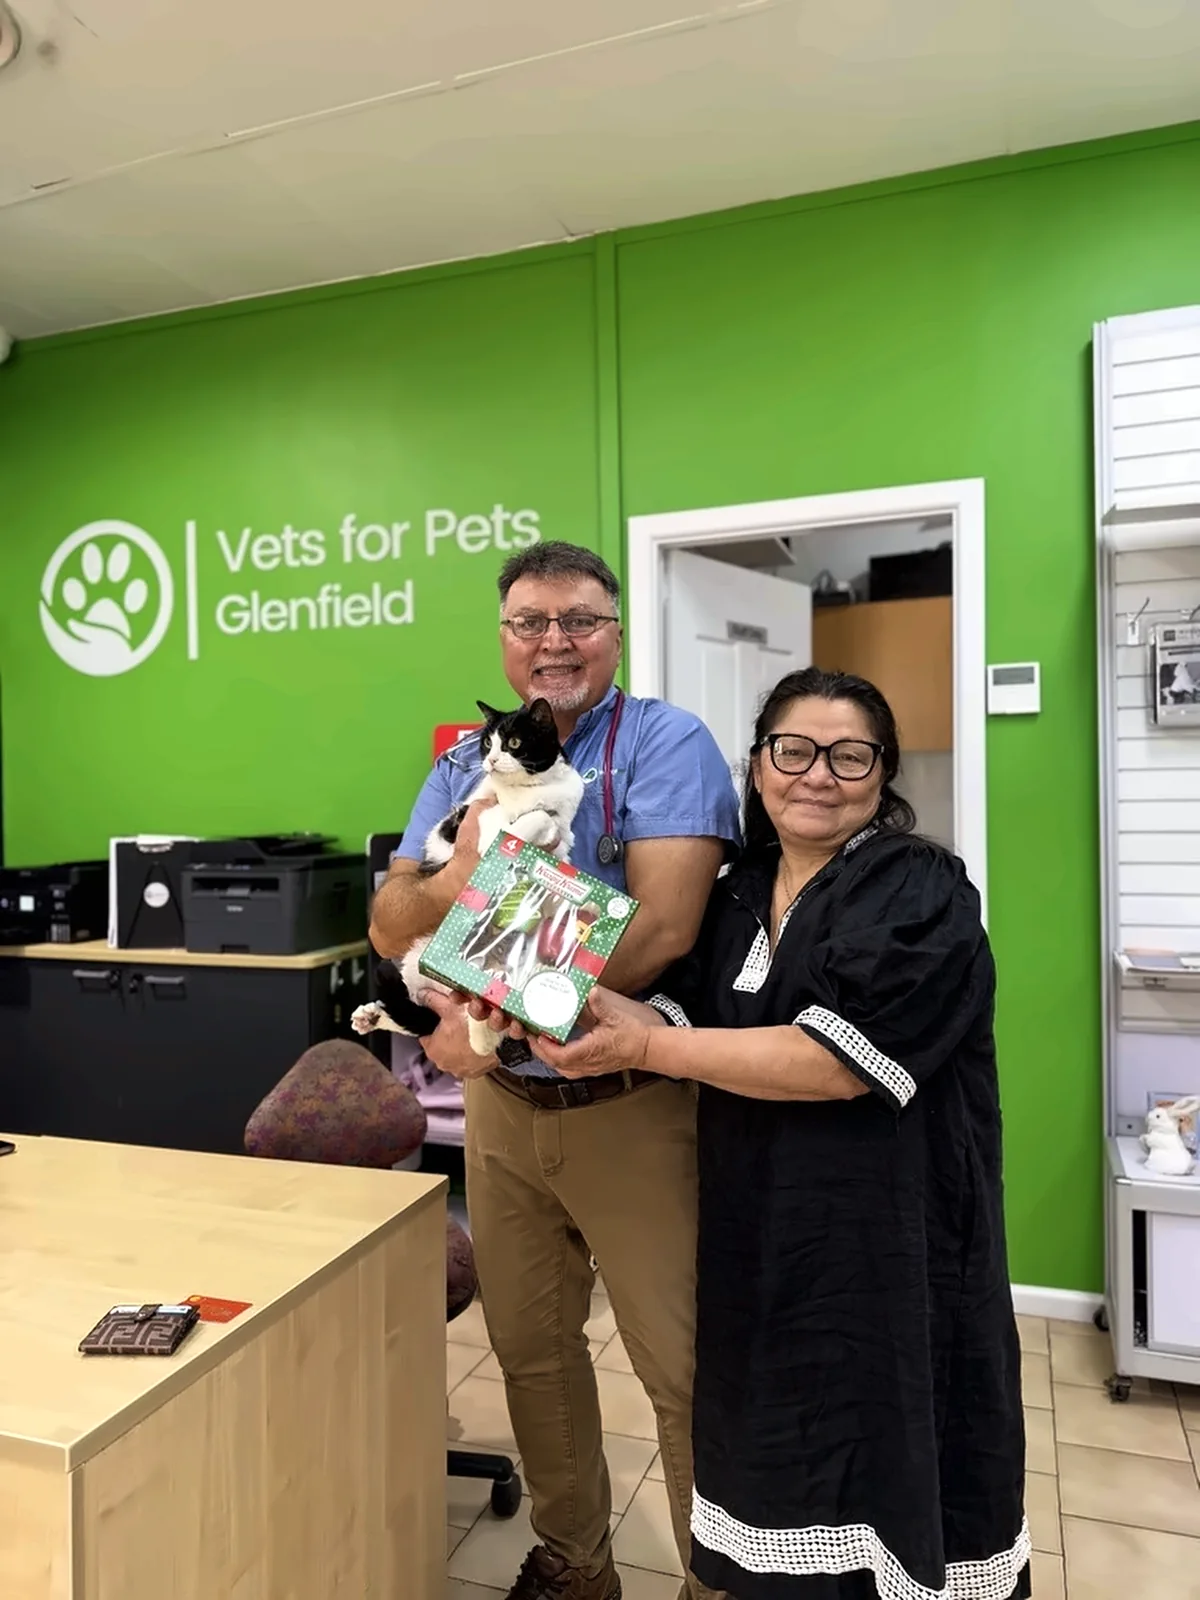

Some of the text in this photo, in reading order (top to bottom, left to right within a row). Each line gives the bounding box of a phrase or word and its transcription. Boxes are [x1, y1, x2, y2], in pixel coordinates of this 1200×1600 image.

[216, 503, 541, 573] Vets for Pets
[215, 579, 415, 635] Glenfield
[507, 839, 517, 850] 4
